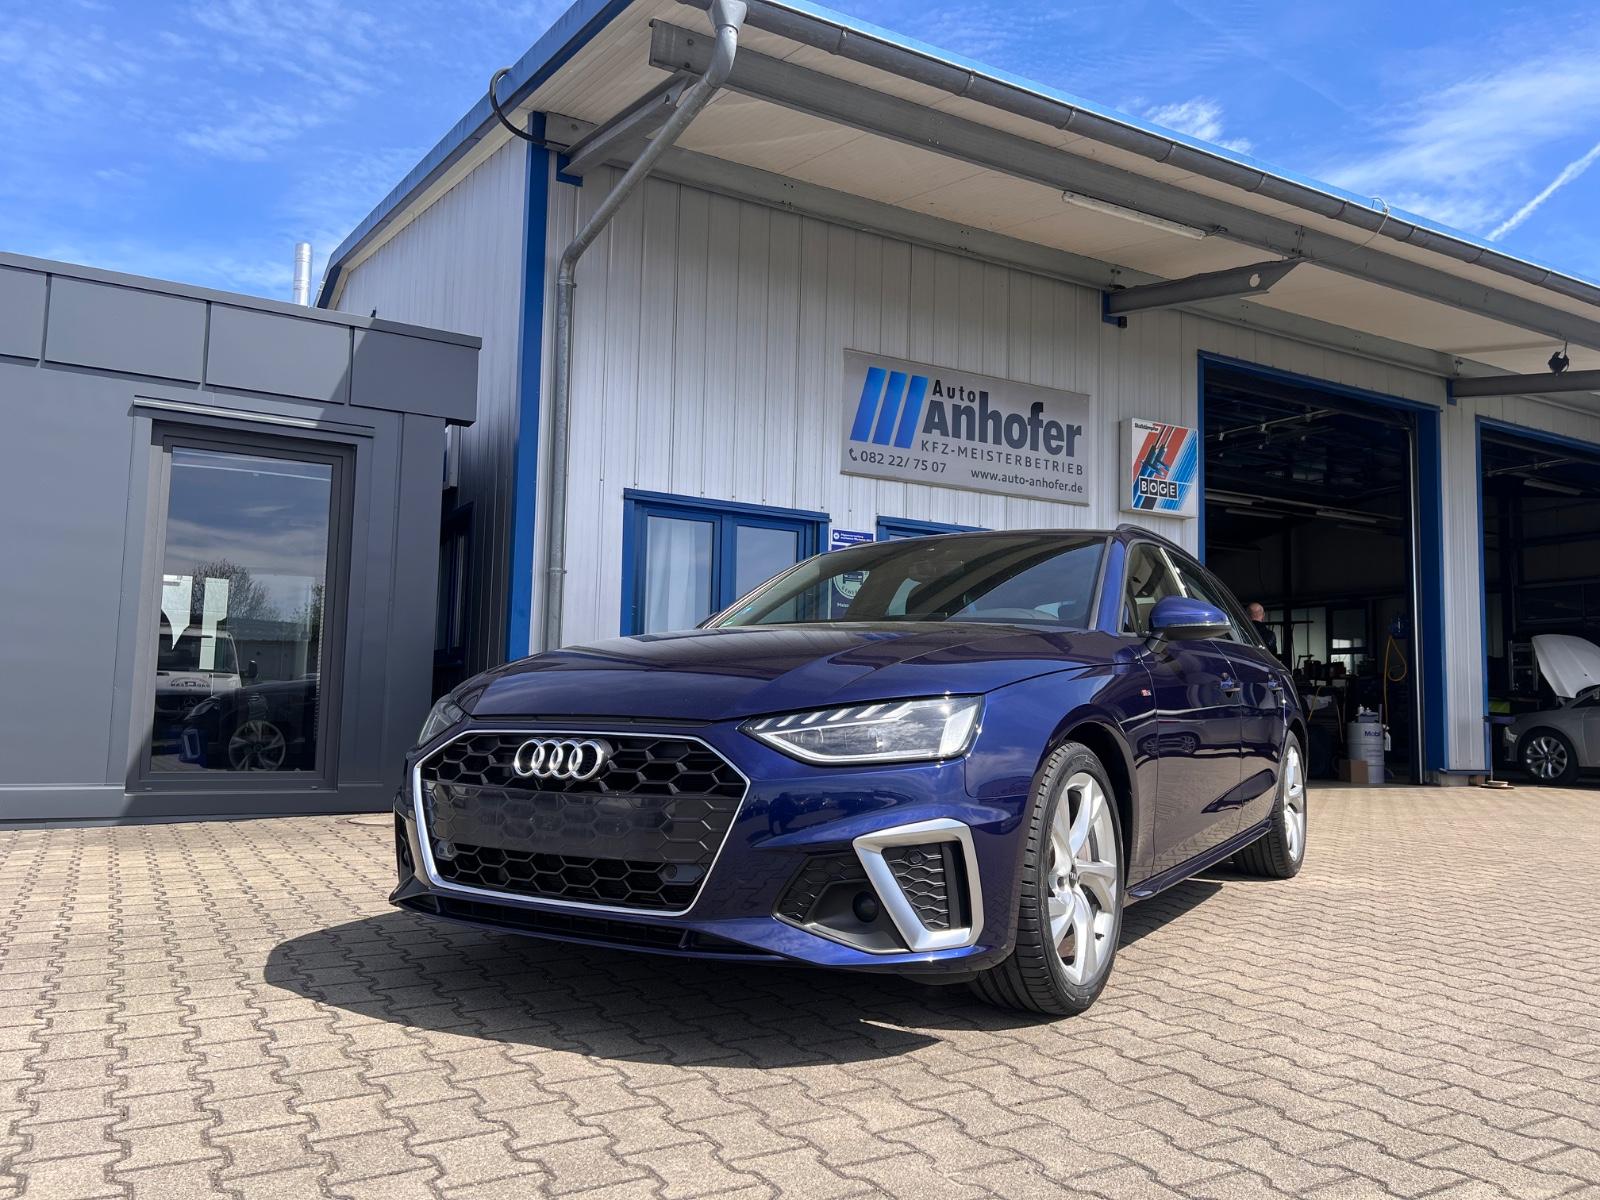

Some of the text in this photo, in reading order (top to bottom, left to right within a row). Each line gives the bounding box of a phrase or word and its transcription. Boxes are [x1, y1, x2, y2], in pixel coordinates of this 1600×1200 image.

[932, 379, 976, 403] Auto
[922, 391, 1082, 458] Anhofer
[860, 450, 947, 473] 082 22/ 75 07
[921, 440, 1083, 476] KFZ-MEISTERBETRIEB
[970, 469, 1083, 494] www.auto-anhofer.de
[1141, 480, 1176, 496] BOGE
